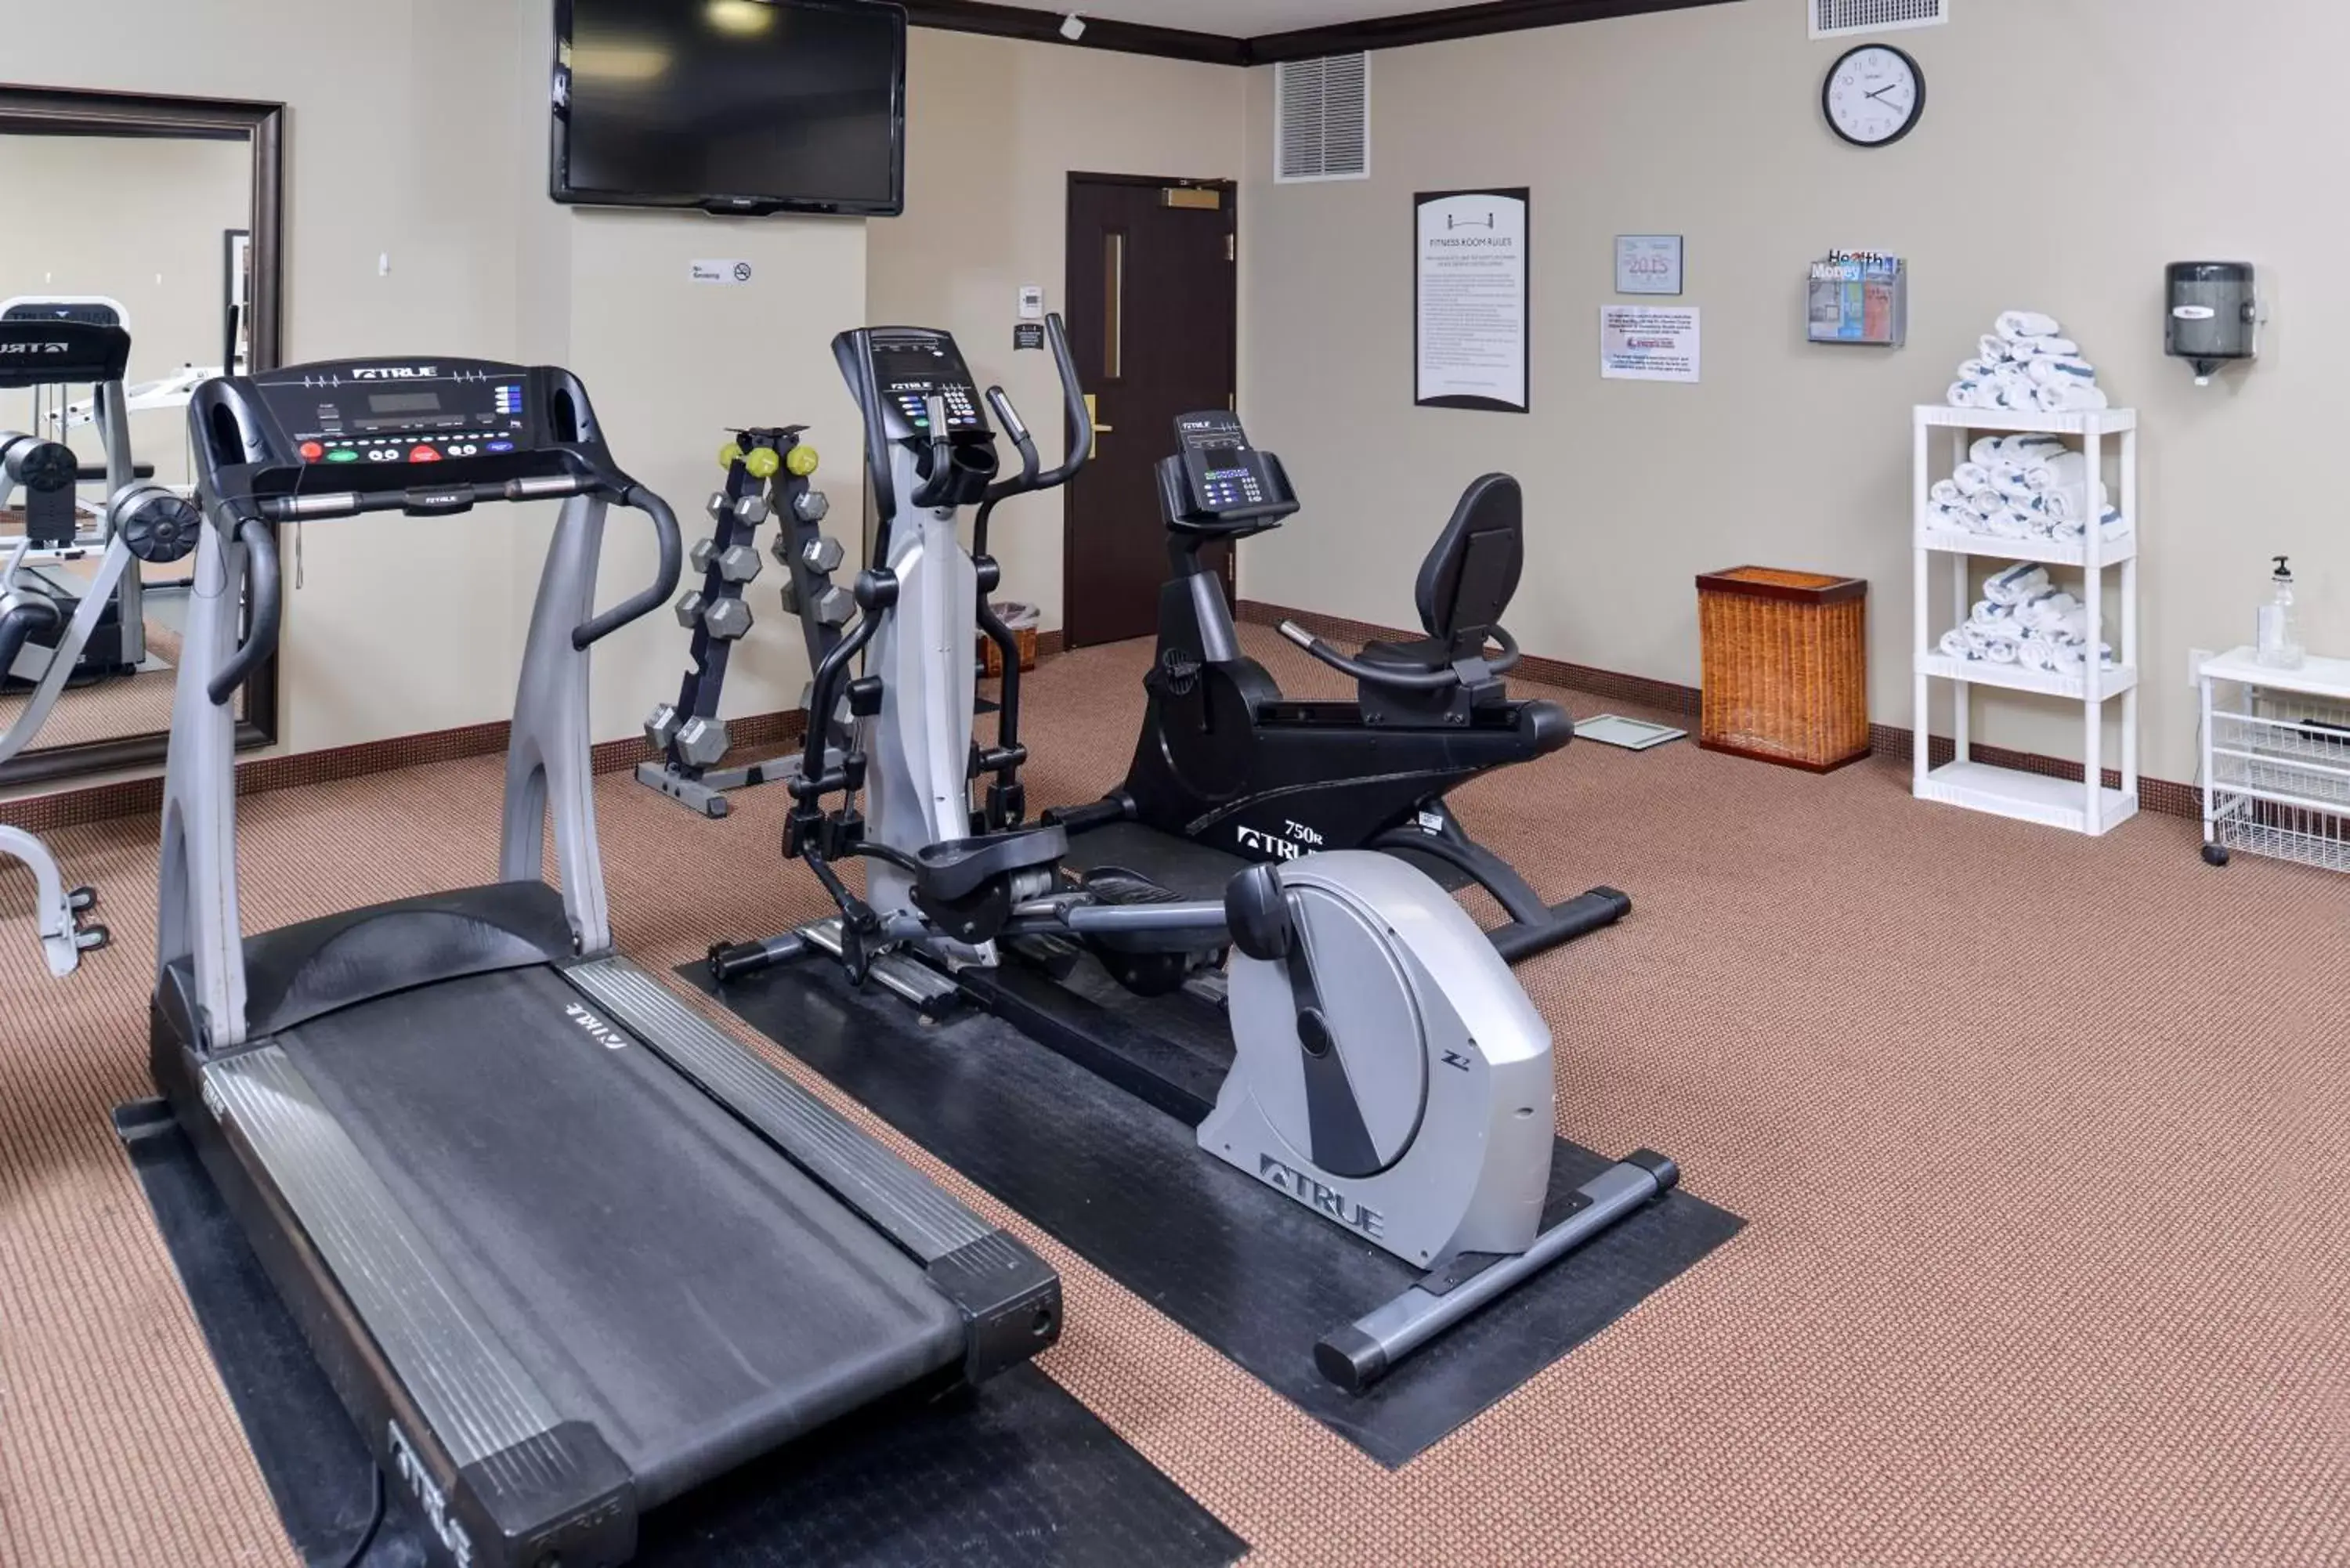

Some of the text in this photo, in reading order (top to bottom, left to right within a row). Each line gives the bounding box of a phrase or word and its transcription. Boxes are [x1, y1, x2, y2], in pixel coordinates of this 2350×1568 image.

[1429, 237, 1512, 247] FITNESS ROOM RULES
[1811, 263, 1860, 281] Money
[376, 366, 438, 379] TRUE
[1285, 818, 1323, 845] 750R
[1289, 1166, 1385, 1241] TRUE
